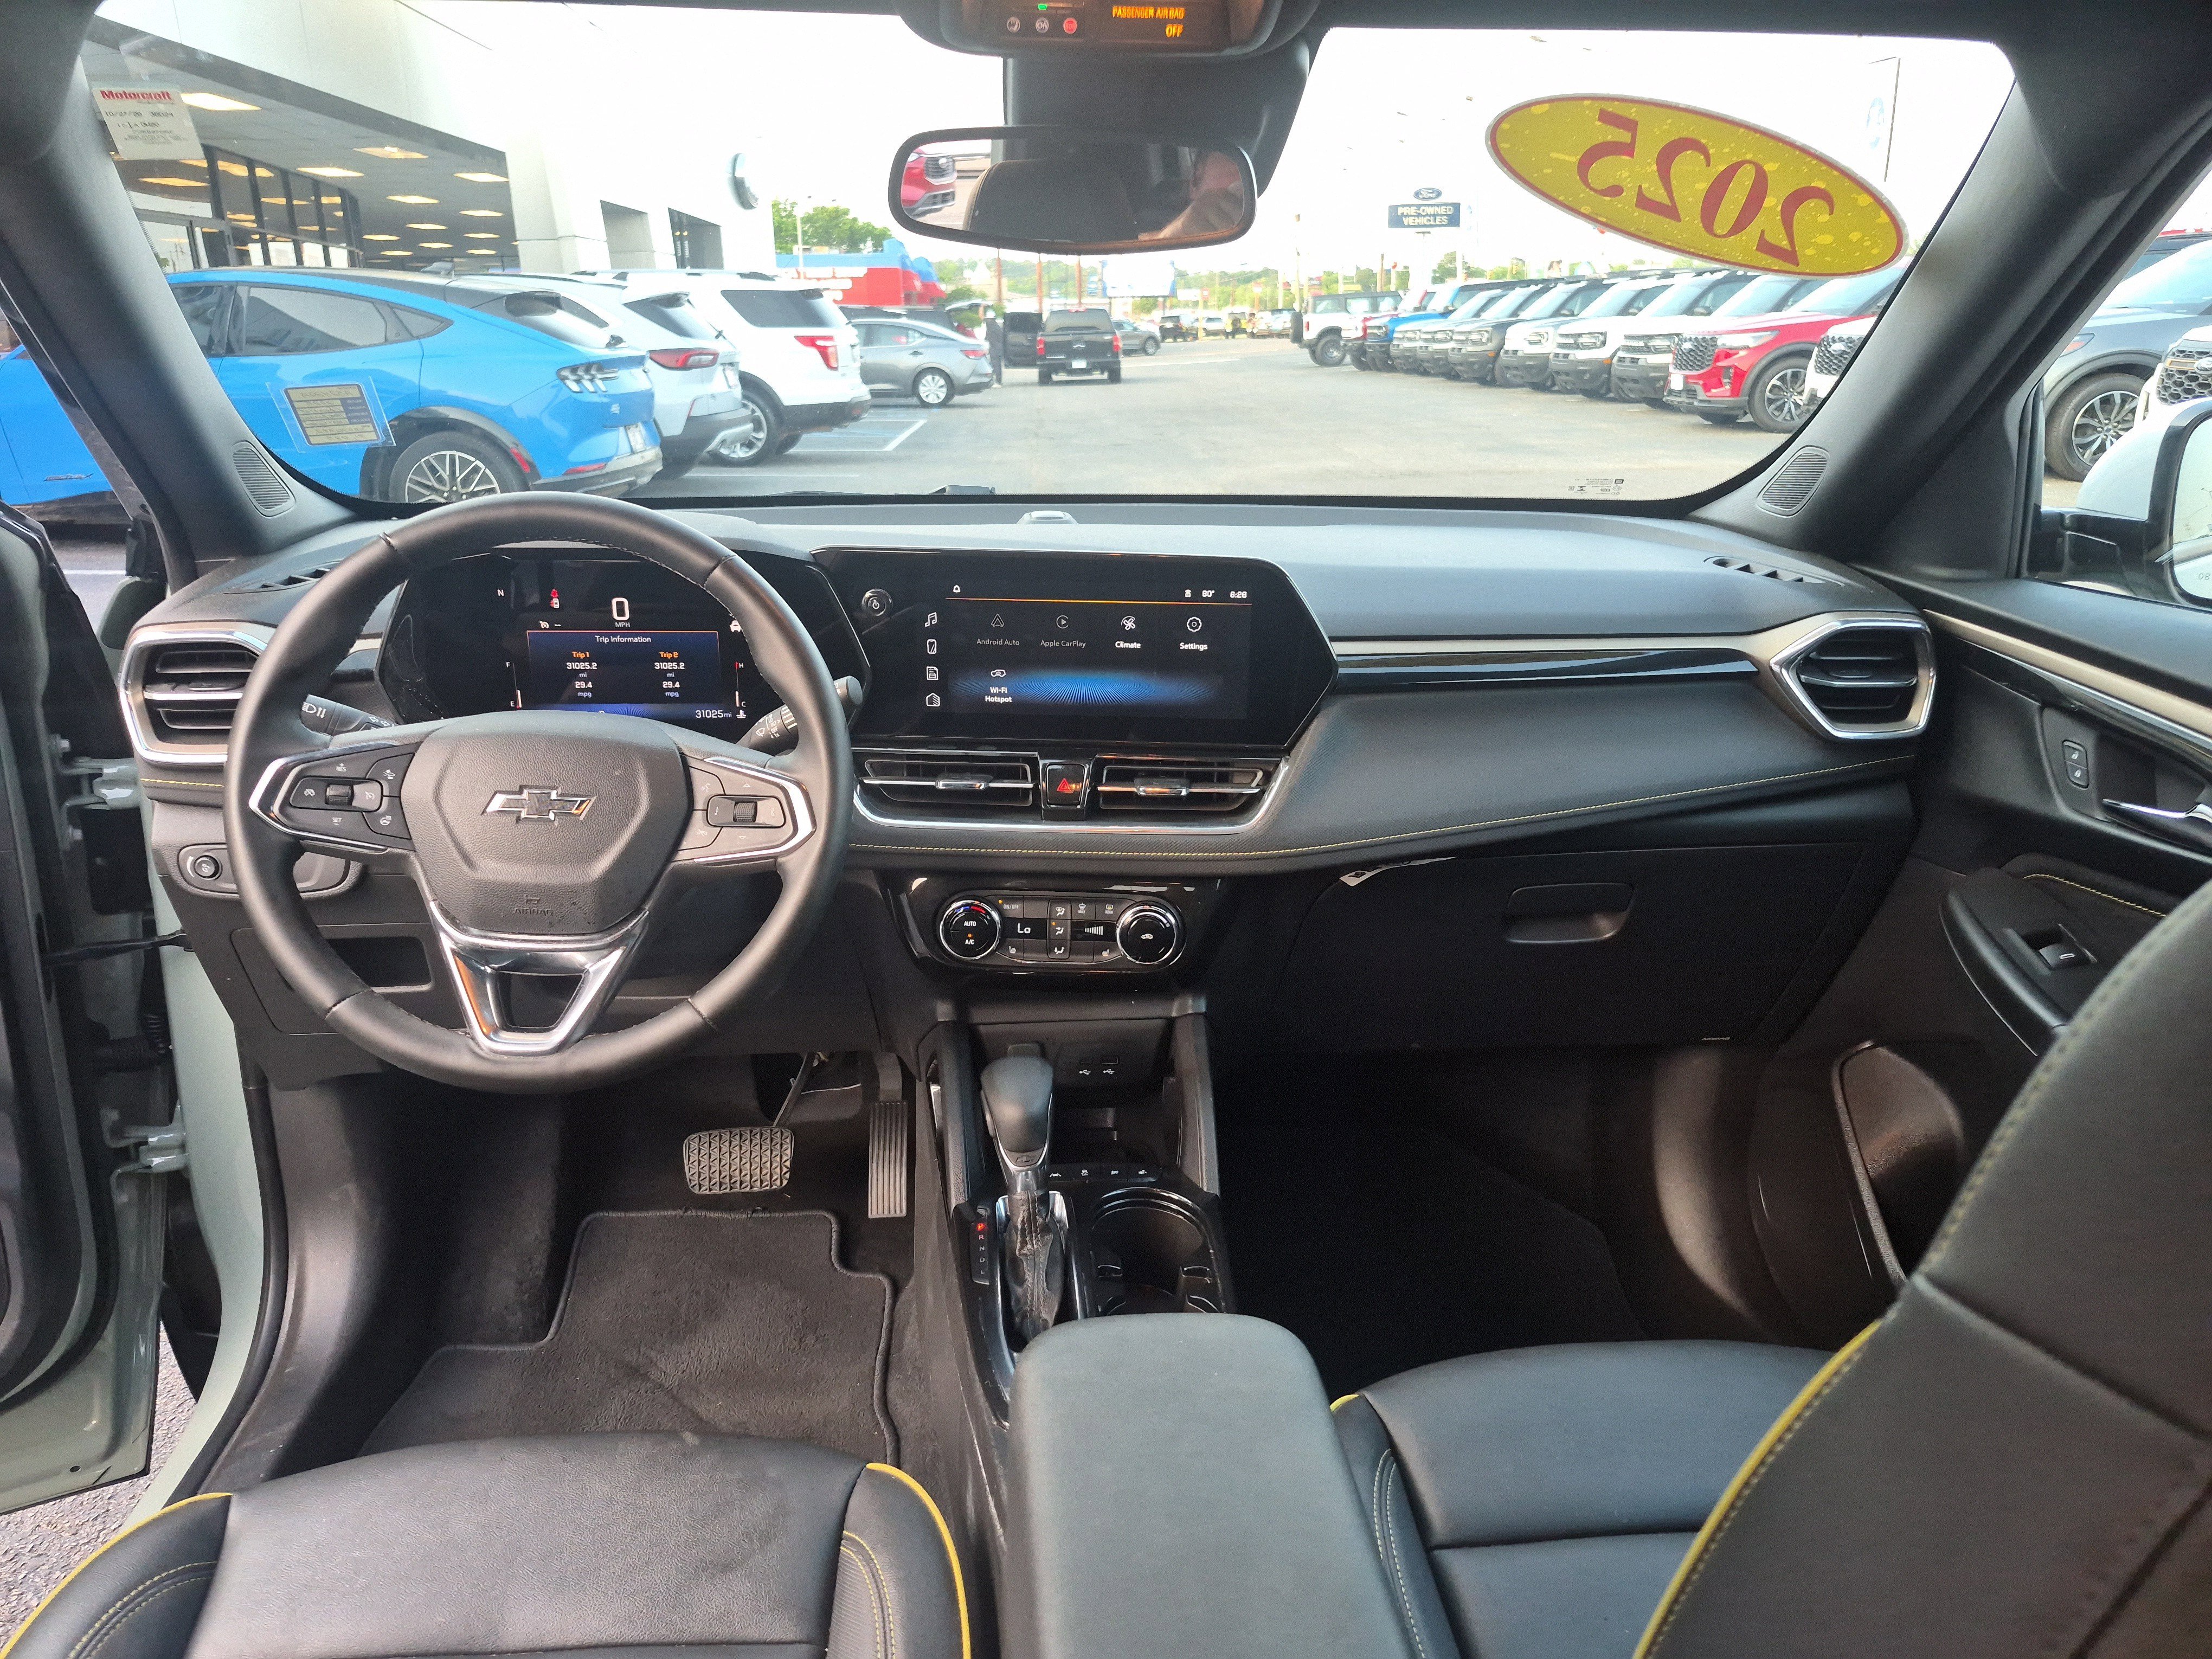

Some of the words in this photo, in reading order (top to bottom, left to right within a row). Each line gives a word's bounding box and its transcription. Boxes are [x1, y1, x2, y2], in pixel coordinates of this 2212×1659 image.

[1112, 5, 1155, 18] PASSENGER
[1166, 23, 1183, 37] OFF
[100, 91, 173, 100] Motorcraft
[1397, 206, 1454, 215] PRE-OWNED
[1403, 216, 1449, 226] VEHICLES
[612, 597, 629, 621] 0
[595, 635, 609, 644] Trip
[1061, 640, 1086, 648] CarPlay
[1180, 642, 1208, 651] Settings
[985, 695, 1012, 704] Hotspot
[515, 907, 554, 917] AIRBAG
